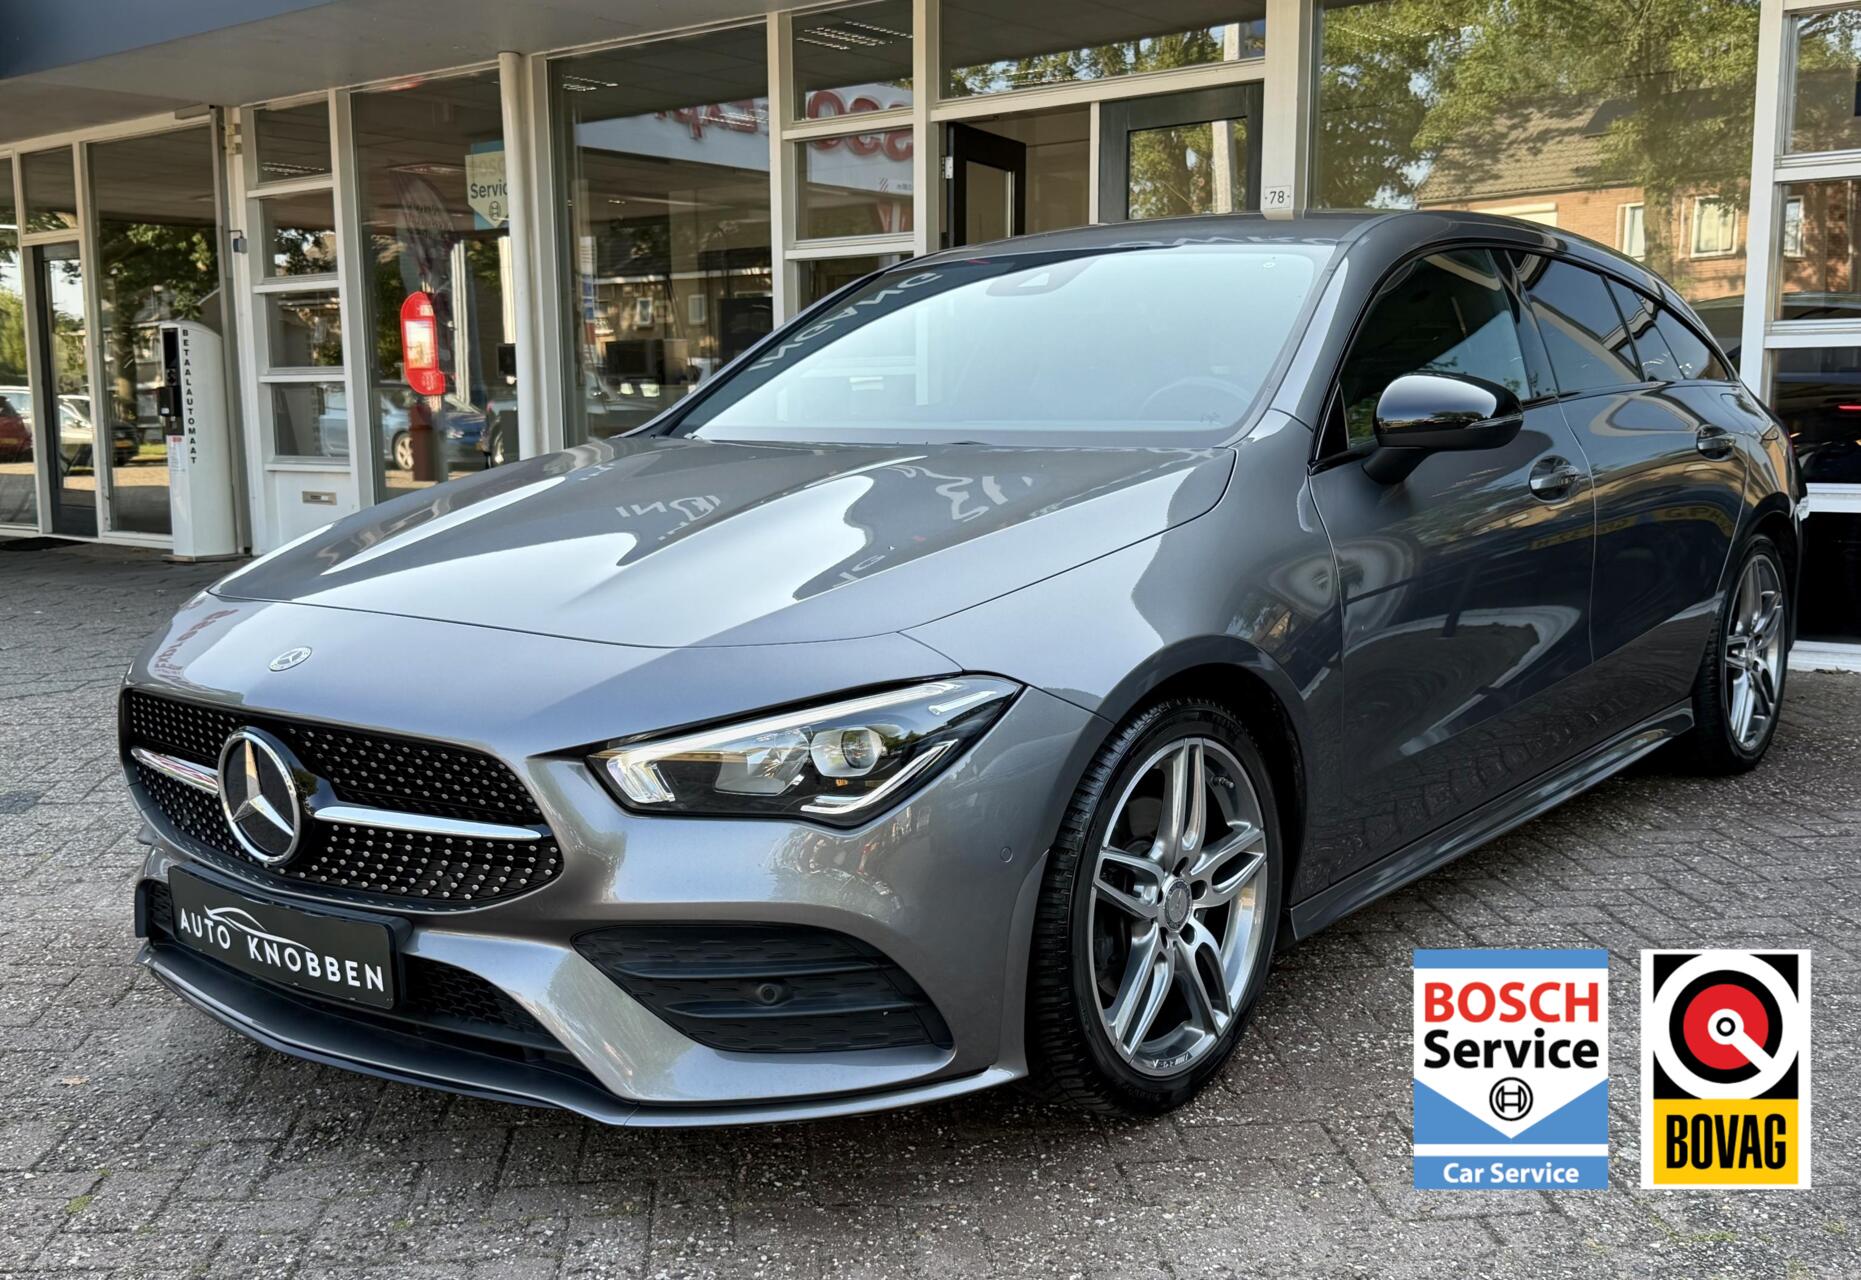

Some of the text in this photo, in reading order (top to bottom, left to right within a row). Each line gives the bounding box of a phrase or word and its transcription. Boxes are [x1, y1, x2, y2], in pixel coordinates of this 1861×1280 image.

[470, 179, 508, 199] Servic
[182, 329, 197, 464] BETAALAUTOMAAT
[180, 908, 384, 992] AUTO KNOBBEN
